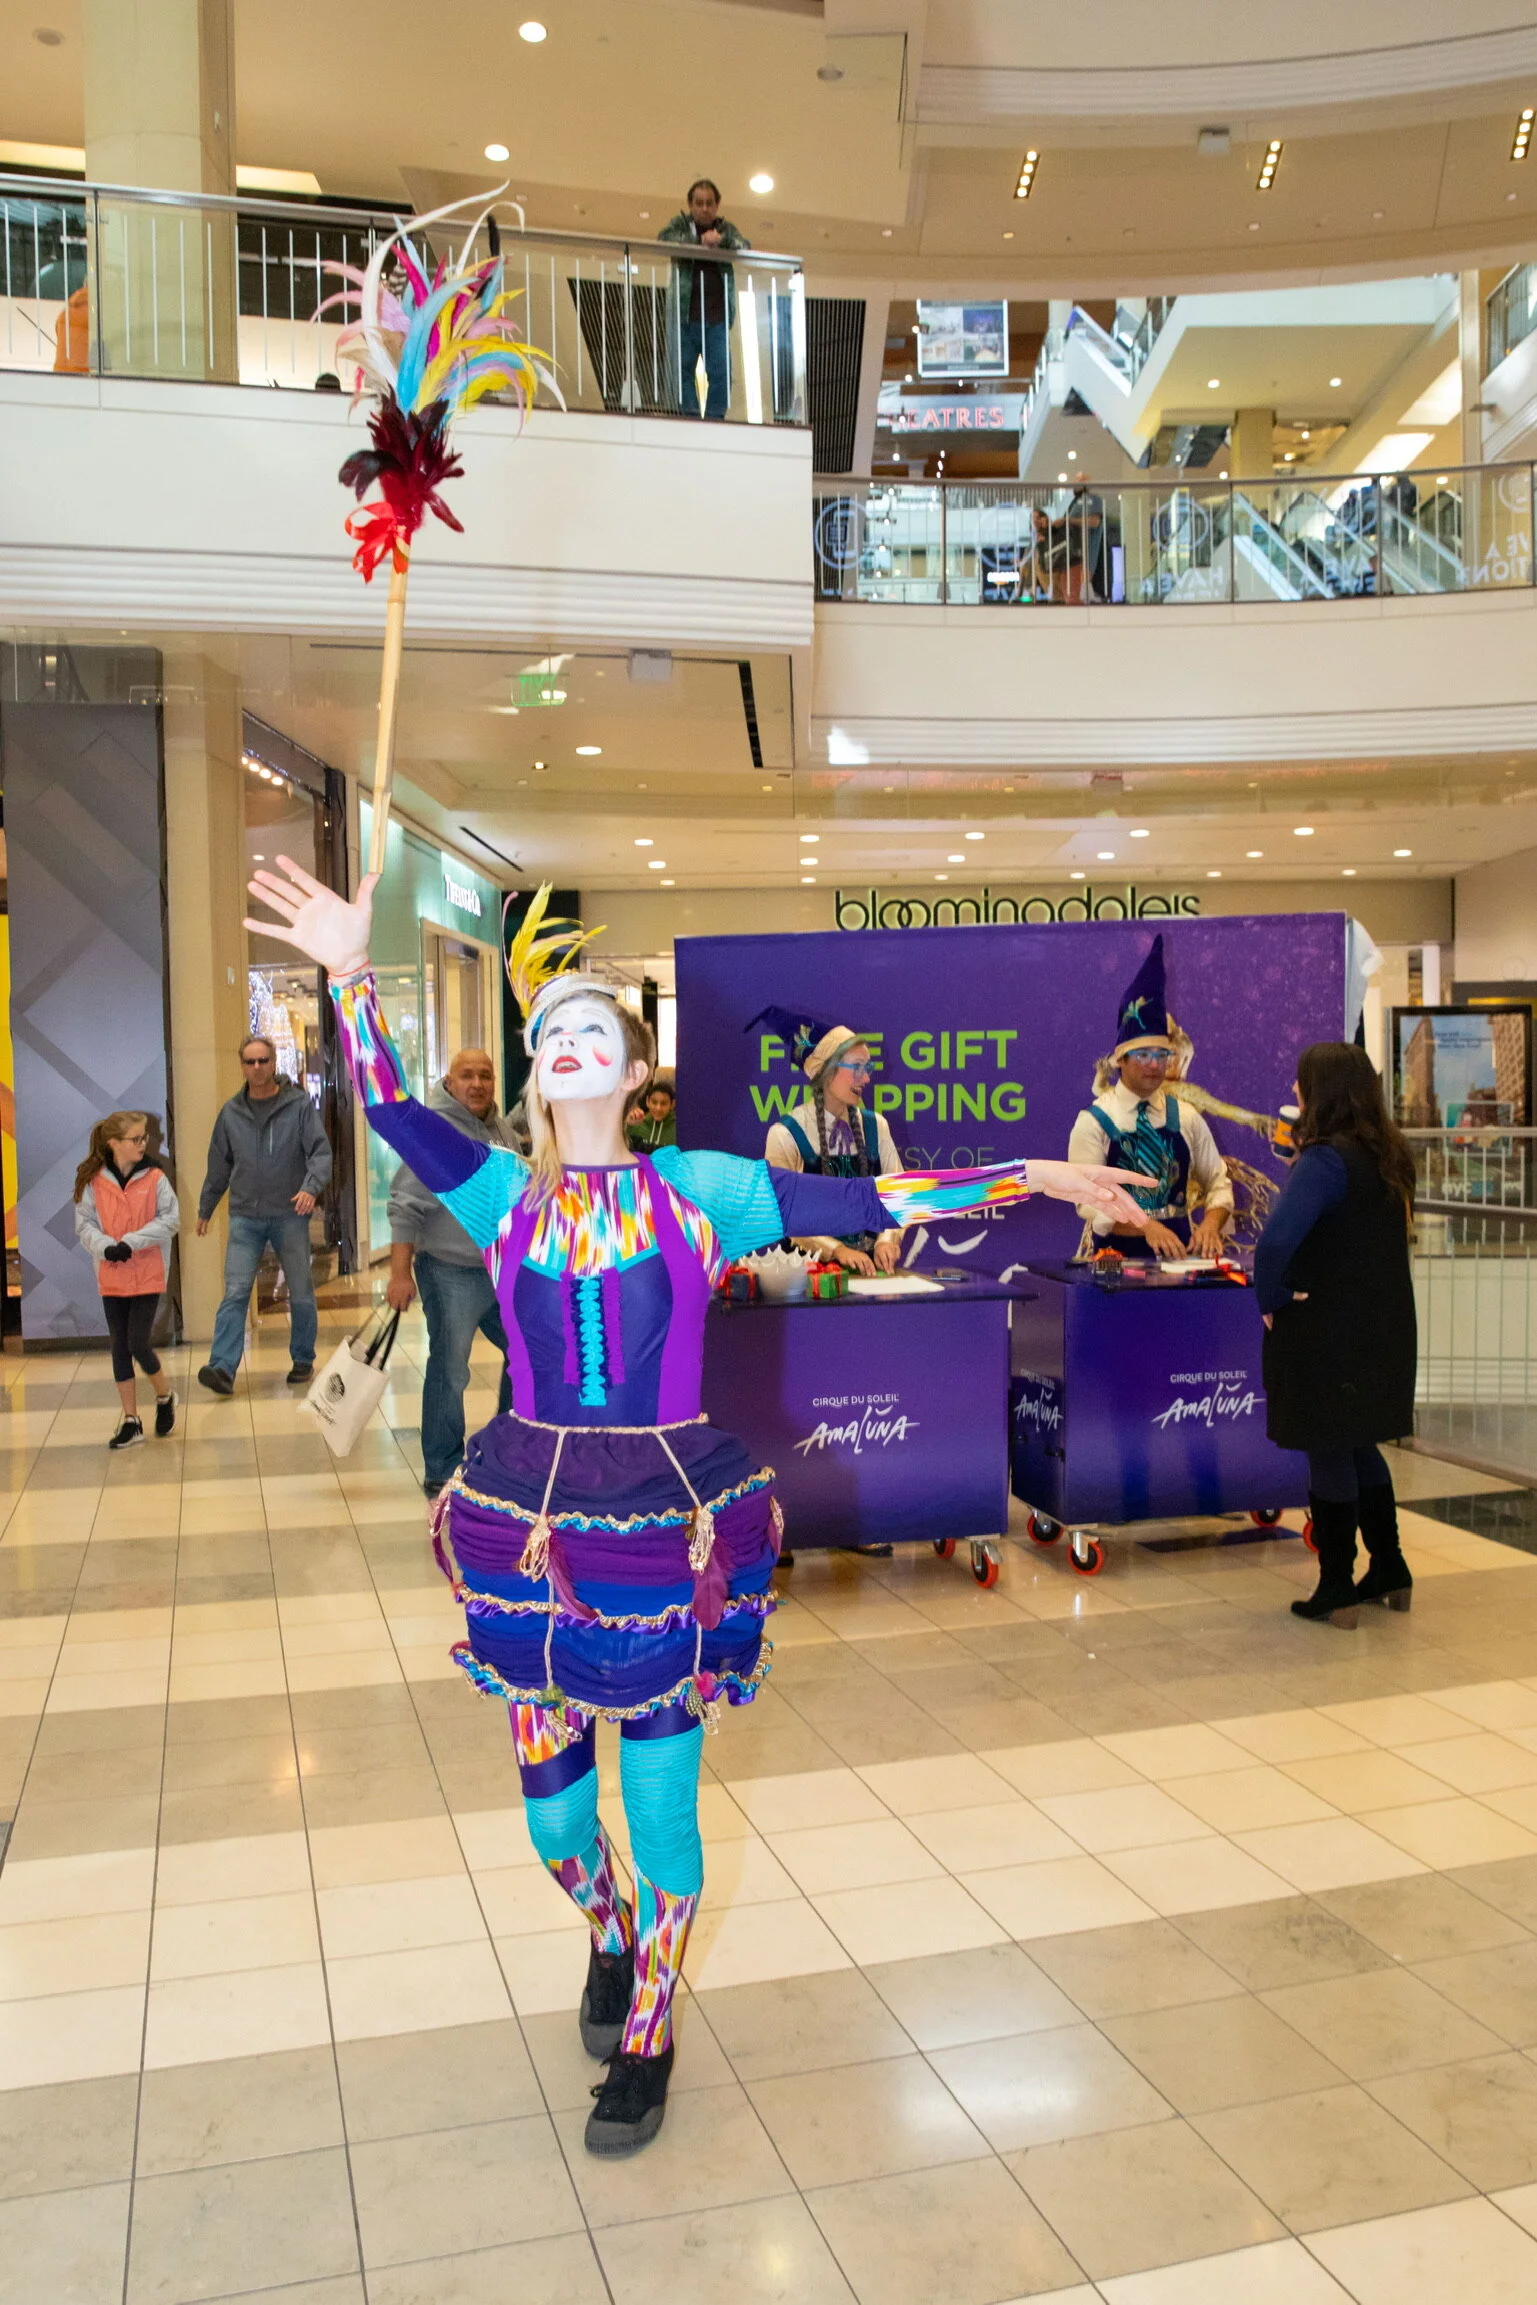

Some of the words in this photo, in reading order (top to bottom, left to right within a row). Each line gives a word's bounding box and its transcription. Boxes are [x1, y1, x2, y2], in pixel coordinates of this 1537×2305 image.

[900, 1030, 1018, 1070] GIFT
[749, 1082, 1027, 1122] WPPING
[1170, 1372, 1203, 1384] CIRQUE
[1204, 1371, 1217, 1381] DU
[1219, 1370, 1248, 1381] SOLEIL
[812, 1395, 849, 1408] CIRQUE
[851, 1395, 865, 1405] DU
[867, 1393, 899, 1404] SOLEIL
